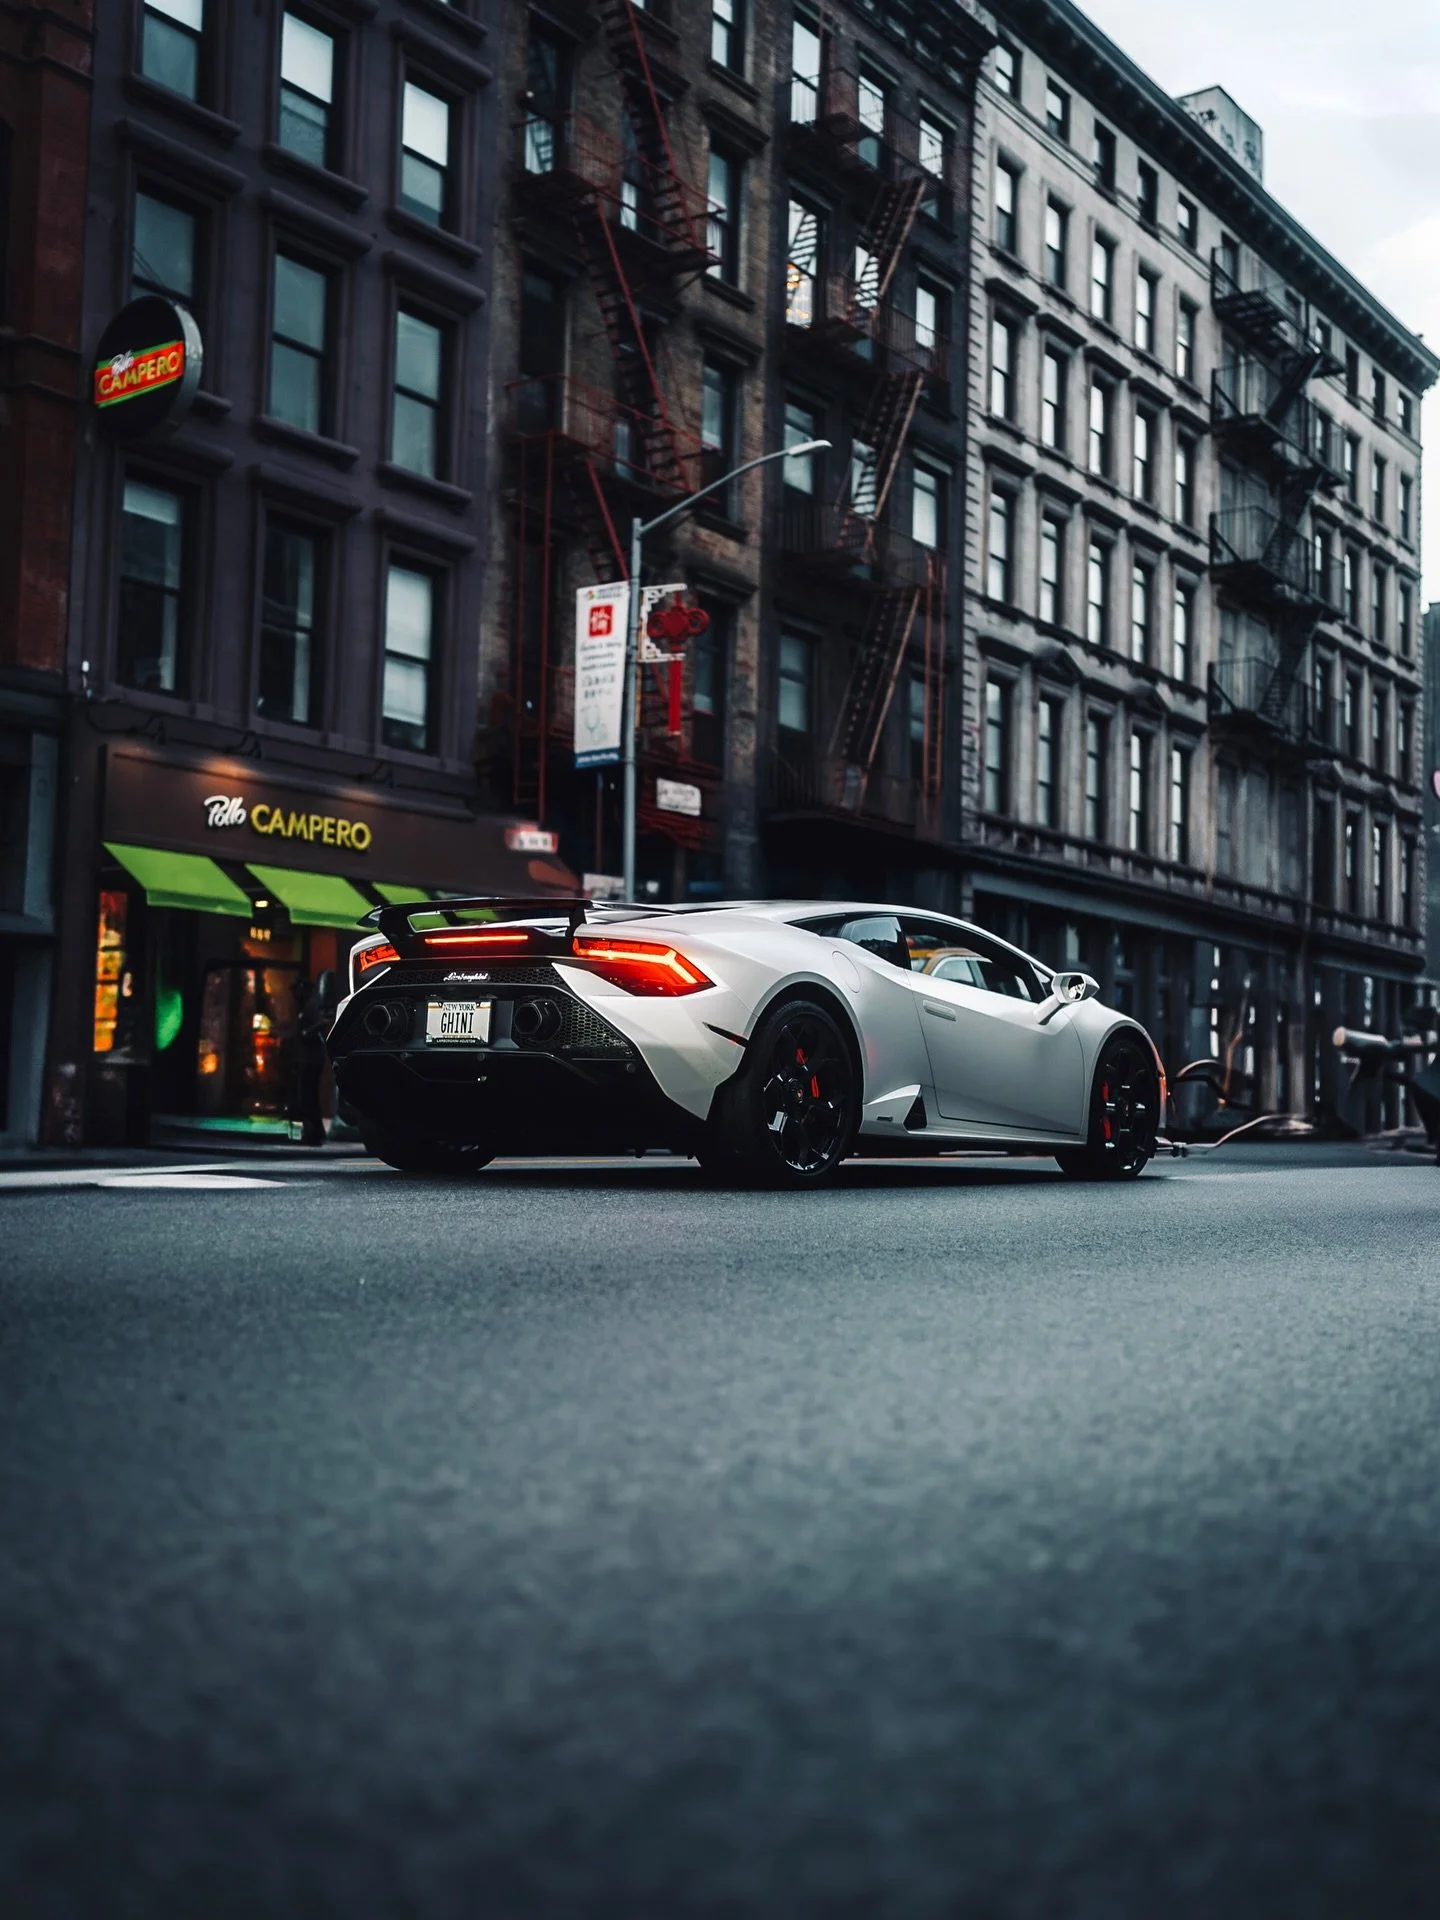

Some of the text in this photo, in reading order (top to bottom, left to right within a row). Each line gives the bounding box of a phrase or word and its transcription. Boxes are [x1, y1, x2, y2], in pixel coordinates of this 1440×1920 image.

[98, 351, 180, 395] CAMPERO
[203, 794, 372, 850] Pollo CAMPERO
[440, 1012, 473, 1033] GHINI
[443, 1003, 476, 1012] NEW YORK
